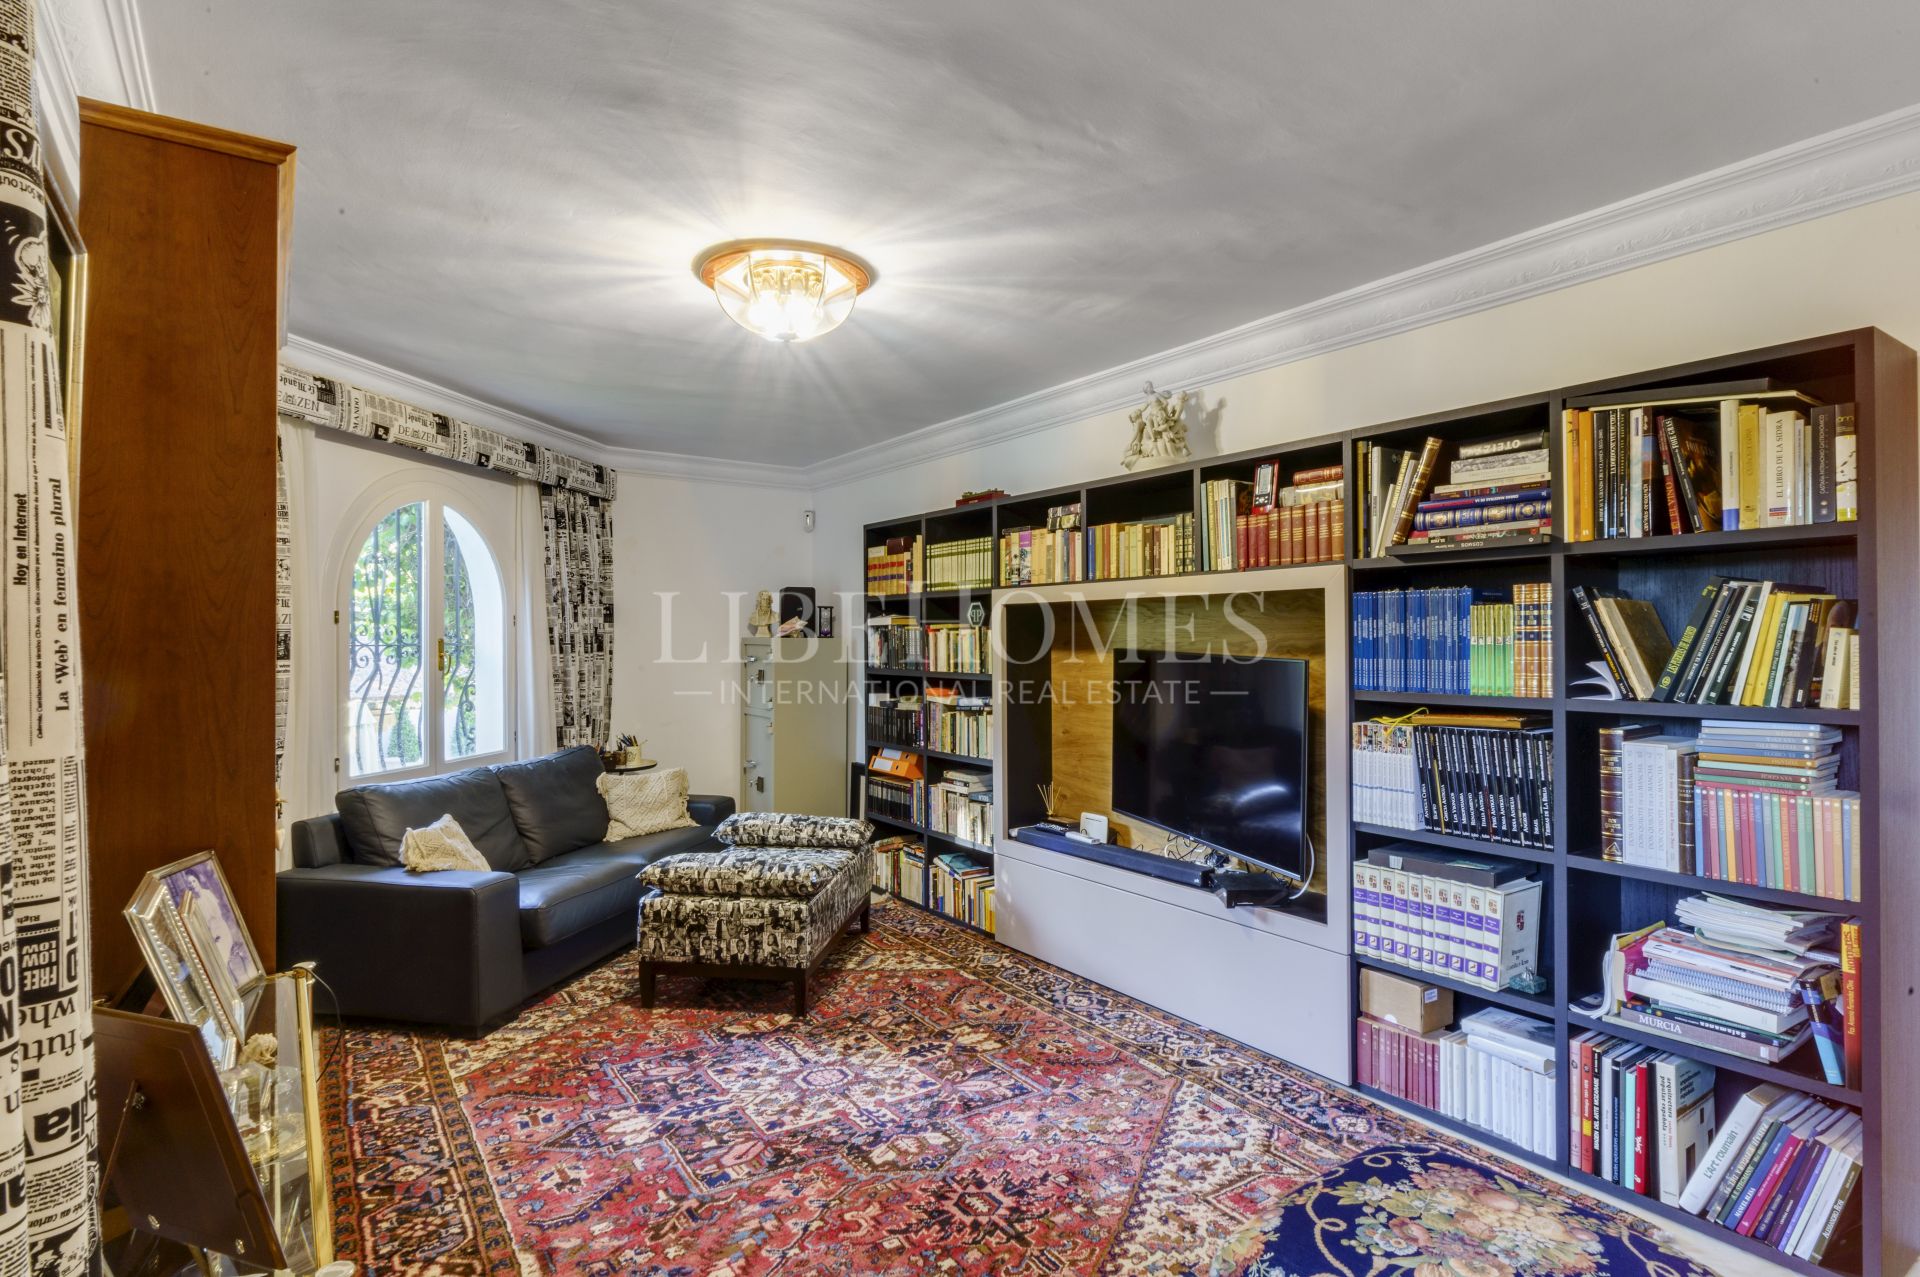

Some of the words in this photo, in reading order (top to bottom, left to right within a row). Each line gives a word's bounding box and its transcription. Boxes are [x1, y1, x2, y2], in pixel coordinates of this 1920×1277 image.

[19, 180, 35, 197] Sort
[297, 396, 319, 412] ZEN
[422, 432, 438, 443] ZEN
[1669, 435, 1680, 449] FOIE
[1776, 443, 1783, 452] LA
[1776, 455, 1783, 464] DE
[49, 478, 66, 526] plural
[1665, 481, 1676, 506] VINO
[13, 493, 27, 541] Internet
[16, 545, 27, 559] en
[1461, 540, 1484, 549] COSMOS
[14, 564, 29, 585] Hoy
[52, 533, 66, 606] femenino
[56, 614, 67, 632] en
[55, 691, 68, 711] La
[12, 782, 55, 790] together
[23, 814, 44, 823] hour
[22, 940, 57, 954] LOW
[22, 949, 56, 968] LOW
[24, 965, 57, 991] FREE
[1638, 1014, 1682, 1035] MURCIA
[1700, 1020, 1746, 1039] Salamanca
[1659, 1076, 1667, 1102] popular
[1665, 1077, 1675, 1118] arquitectura
[1660, 1103, 1669, 1131] española
[1702, 1160, 1720, 1179] L'Art
[1713, 1129, 1739, 1162] roumain
[1734, 1199, 1749, 1219] MANUEL
